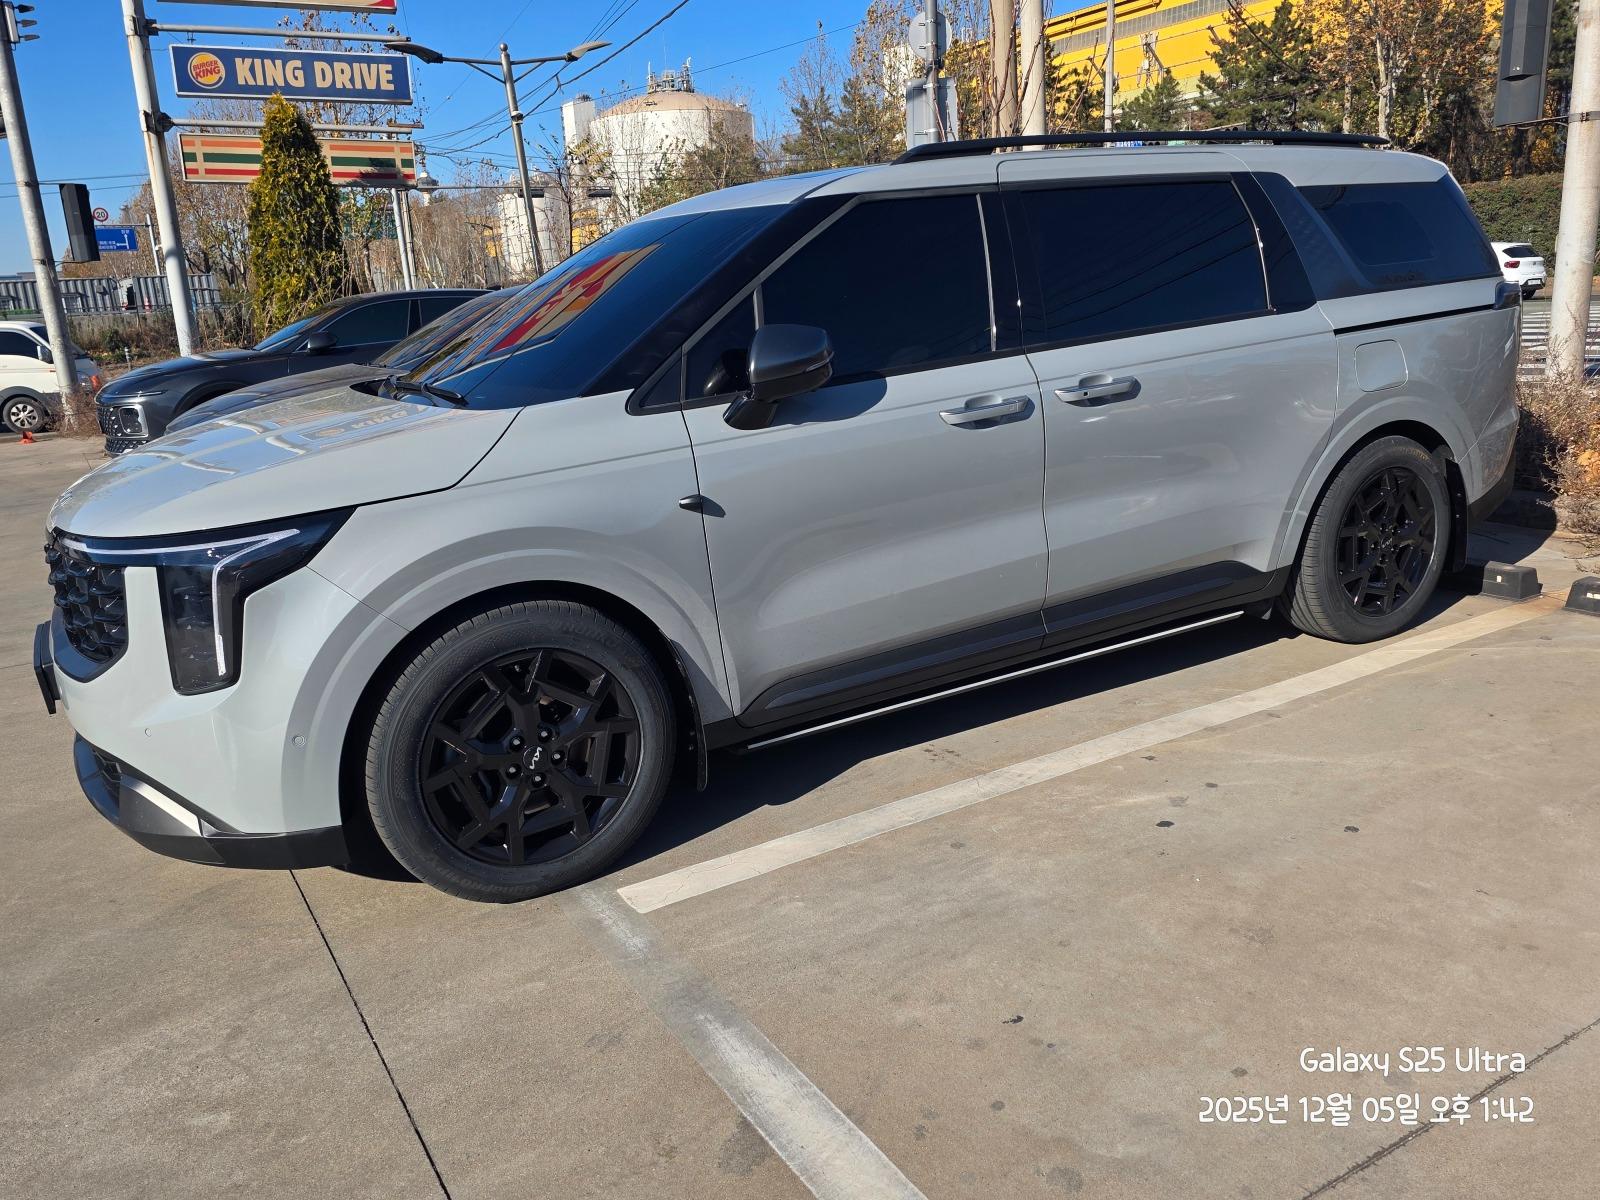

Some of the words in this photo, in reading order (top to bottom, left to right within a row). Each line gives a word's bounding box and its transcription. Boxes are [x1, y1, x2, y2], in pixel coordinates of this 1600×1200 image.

[192, 60, 218, 72] BURGER
[195, 65, 221, 80] KING
[234, 57, 305, 87] KING
[313, 61, 395, 91] DRIVE
[95, 211, 106, 219] 20
